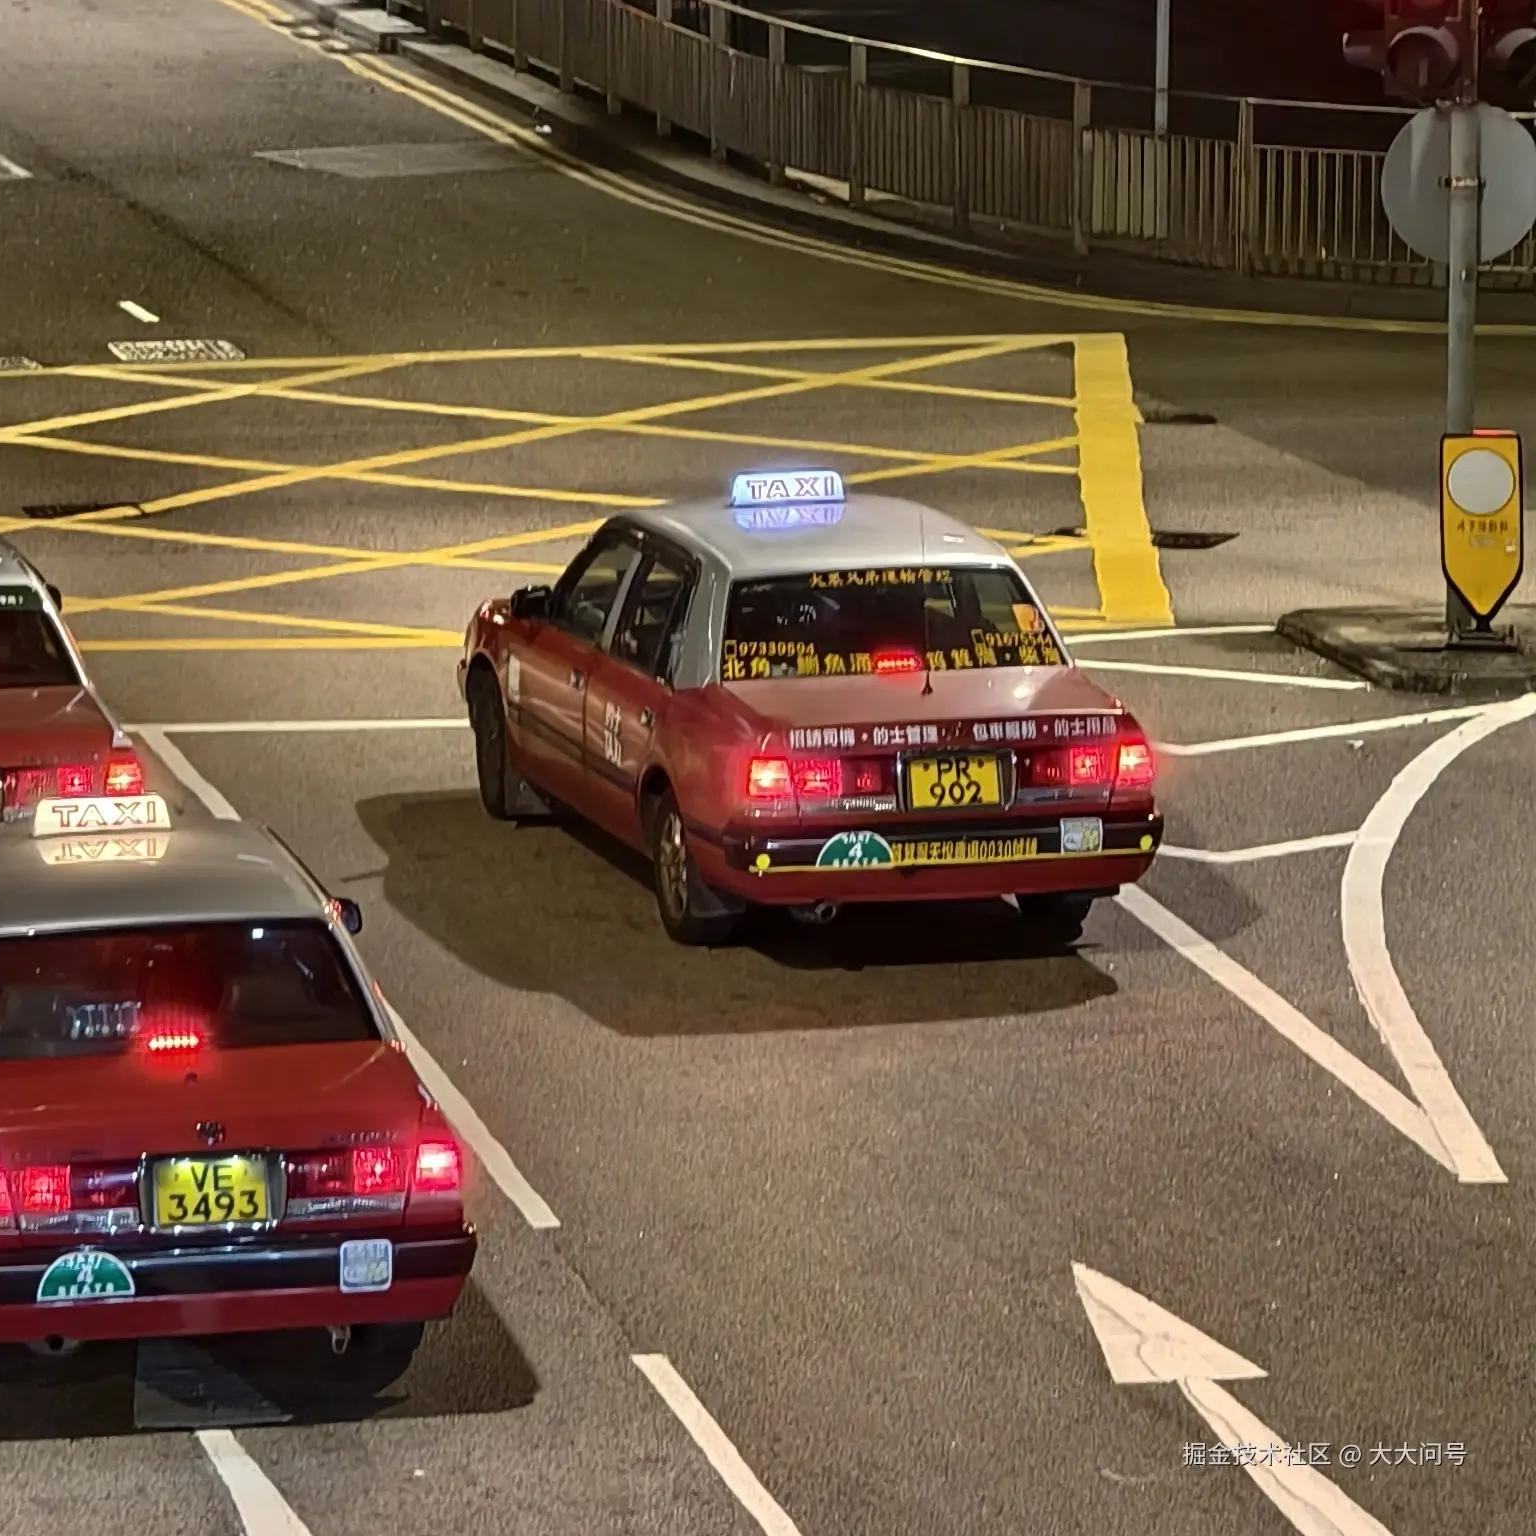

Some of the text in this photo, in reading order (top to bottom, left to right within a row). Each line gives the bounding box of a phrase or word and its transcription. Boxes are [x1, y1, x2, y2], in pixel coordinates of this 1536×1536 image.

[746, 475, 835, 500] TAXI
[936, 757, 972, 783] PR
[930, 780, 983, 806] 902
[52, 800, 157, 828] TAXI
[848, 842, 863, 859] 4
[191, 1164, 234, 1192] VE
[168, 1190, 259, 1221] 3493
